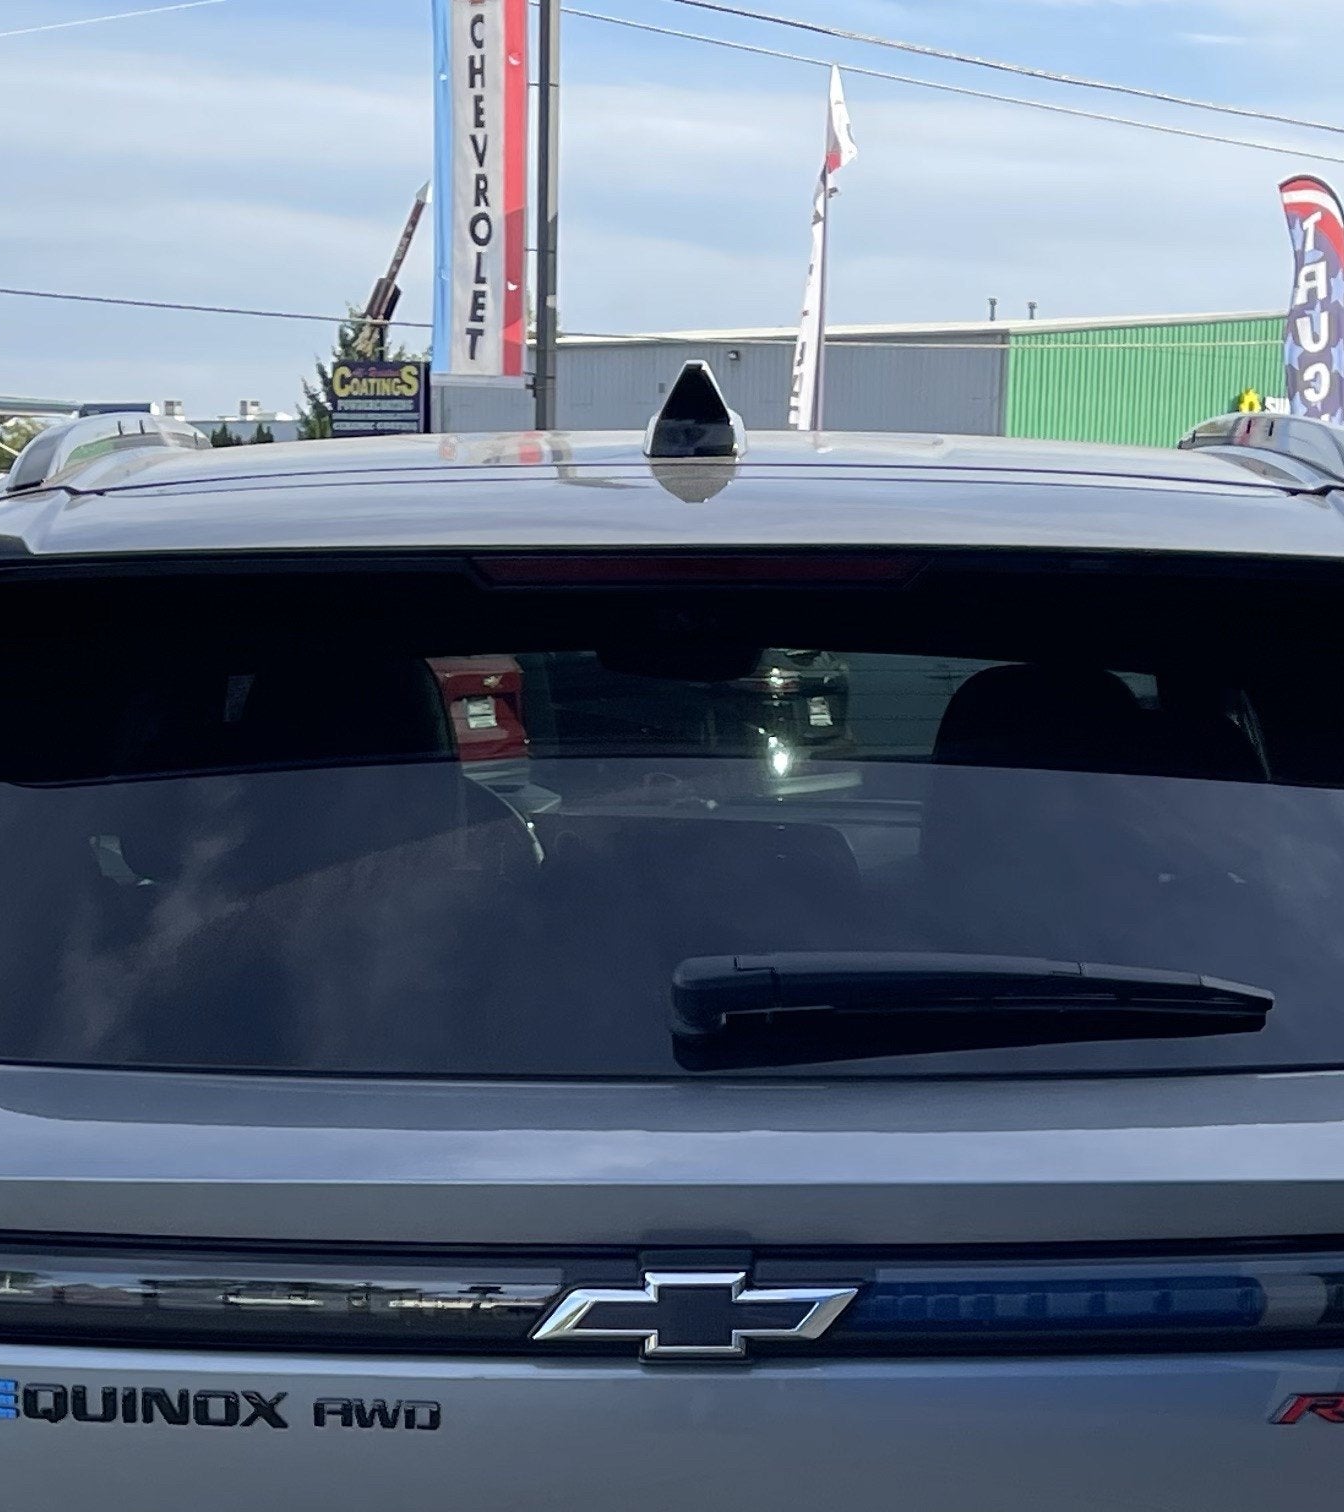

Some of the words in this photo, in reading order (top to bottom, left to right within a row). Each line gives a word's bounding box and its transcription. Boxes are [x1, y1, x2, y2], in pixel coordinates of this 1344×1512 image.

[465, 13, 493, 360] CHEVROLET
[332, 365, 419, 397] COATINGS
[312, 1396, 442, 1431] AWD
